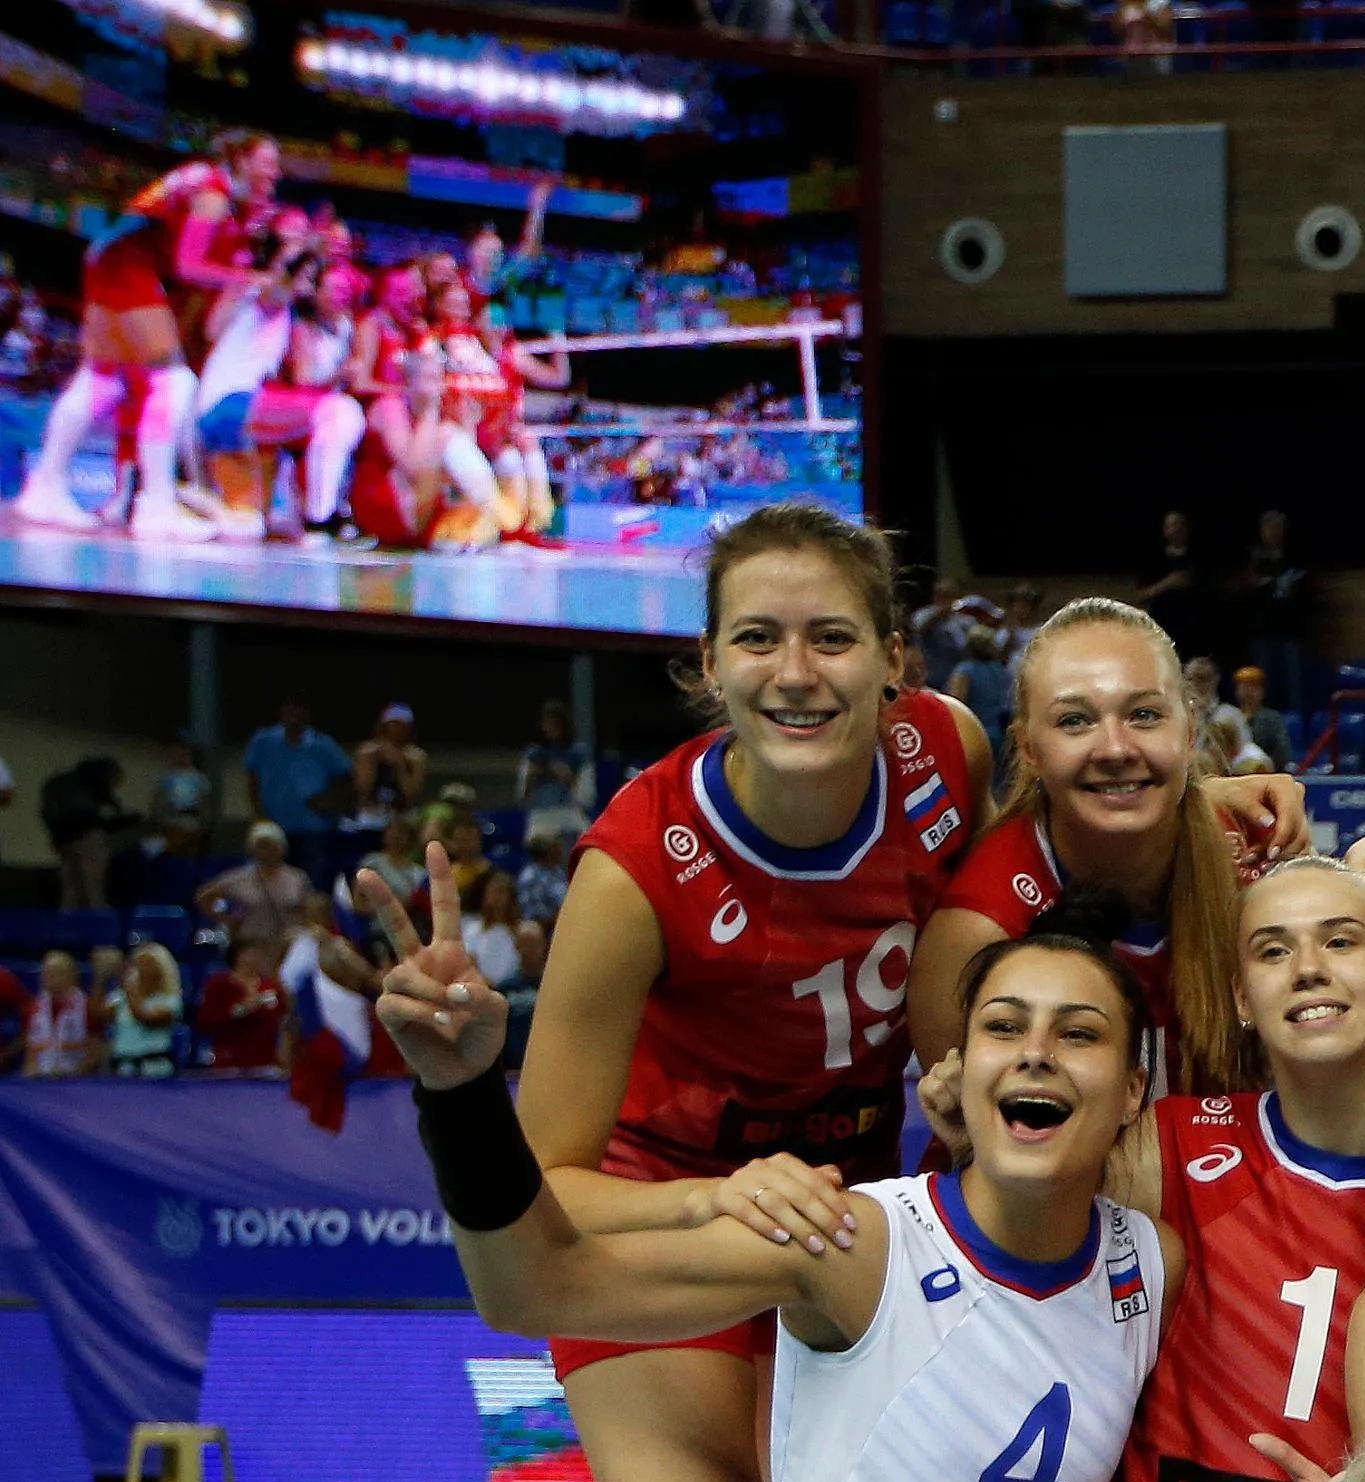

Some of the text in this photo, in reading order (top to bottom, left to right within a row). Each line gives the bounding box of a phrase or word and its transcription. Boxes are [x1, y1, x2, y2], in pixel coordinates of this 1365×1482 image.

[926, 814, 956, 846] RS
[675, 851, 718, 885] ROSGE
[793, 921, 917, 1071] 19
[1191, 1114, 1242, 1127] ROSGE
[213, 1207, 351, 1247] TOKYO
[1279, 1265, 1339, 1422] 1
